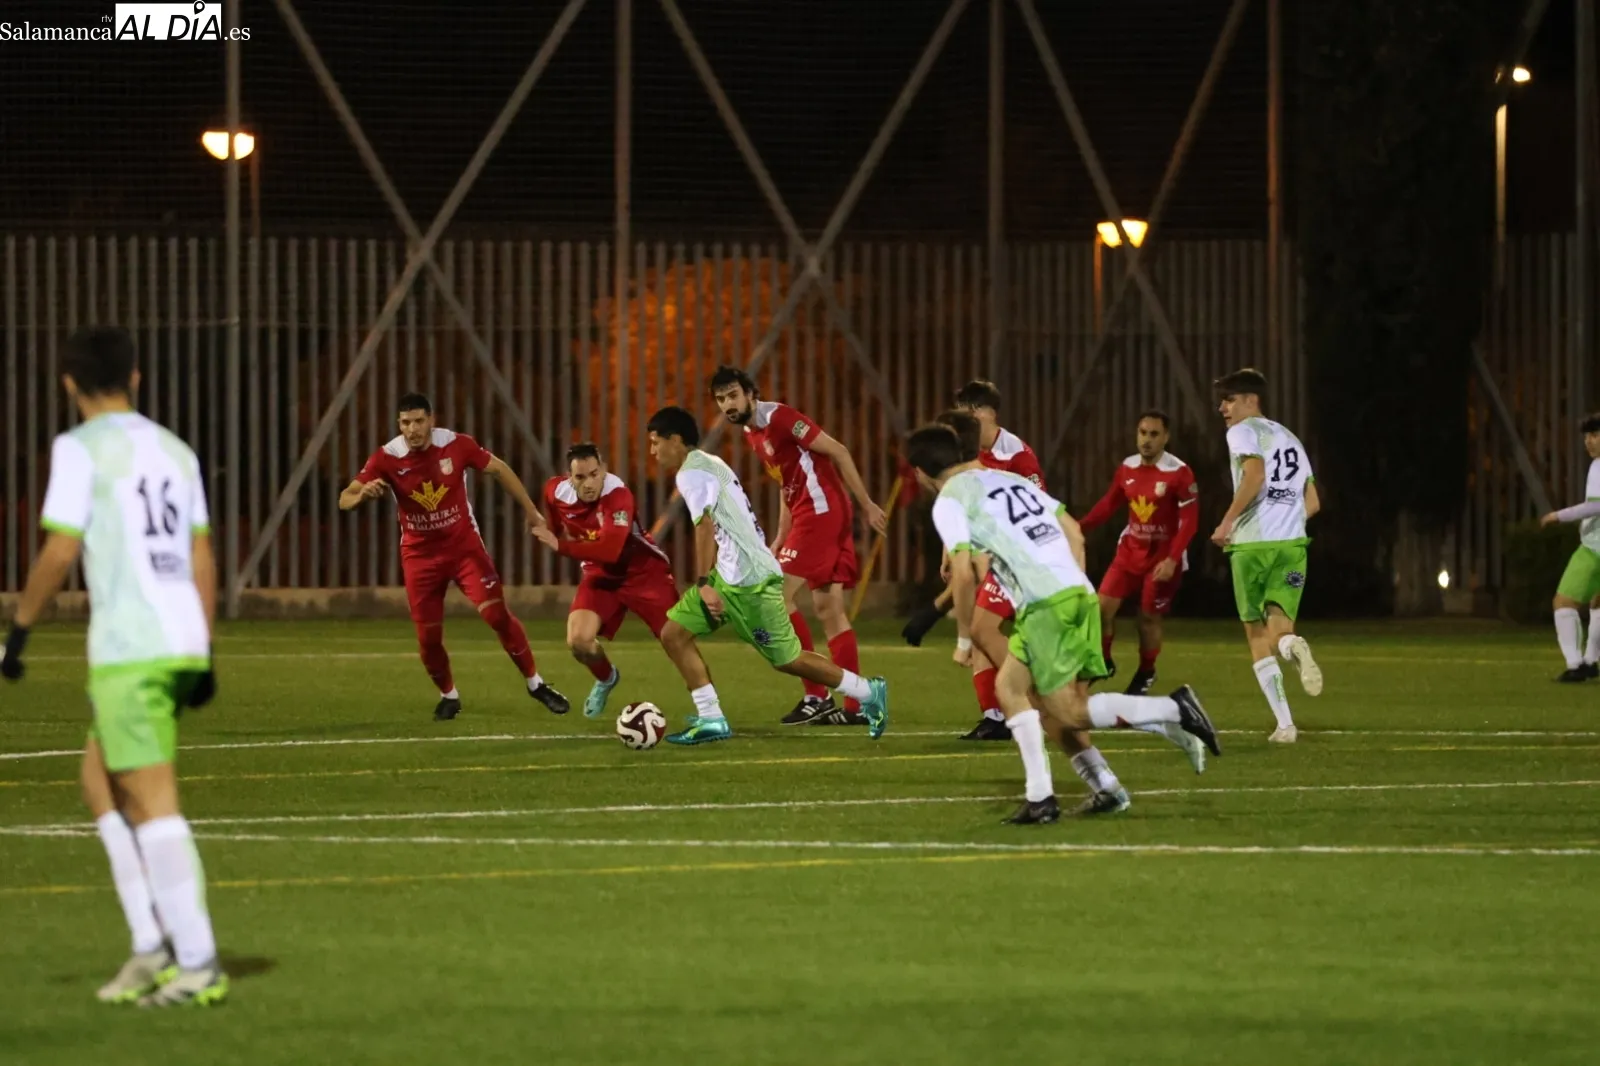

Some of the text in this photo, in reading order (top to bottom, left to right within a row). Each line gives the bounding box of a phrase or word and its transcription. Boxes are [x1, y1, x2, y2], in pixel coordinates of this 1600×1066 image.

[1270, 447, 1300, 482] 19
[137, 476, 178, 536] 16
[987, 484, 1045, 526] 20
